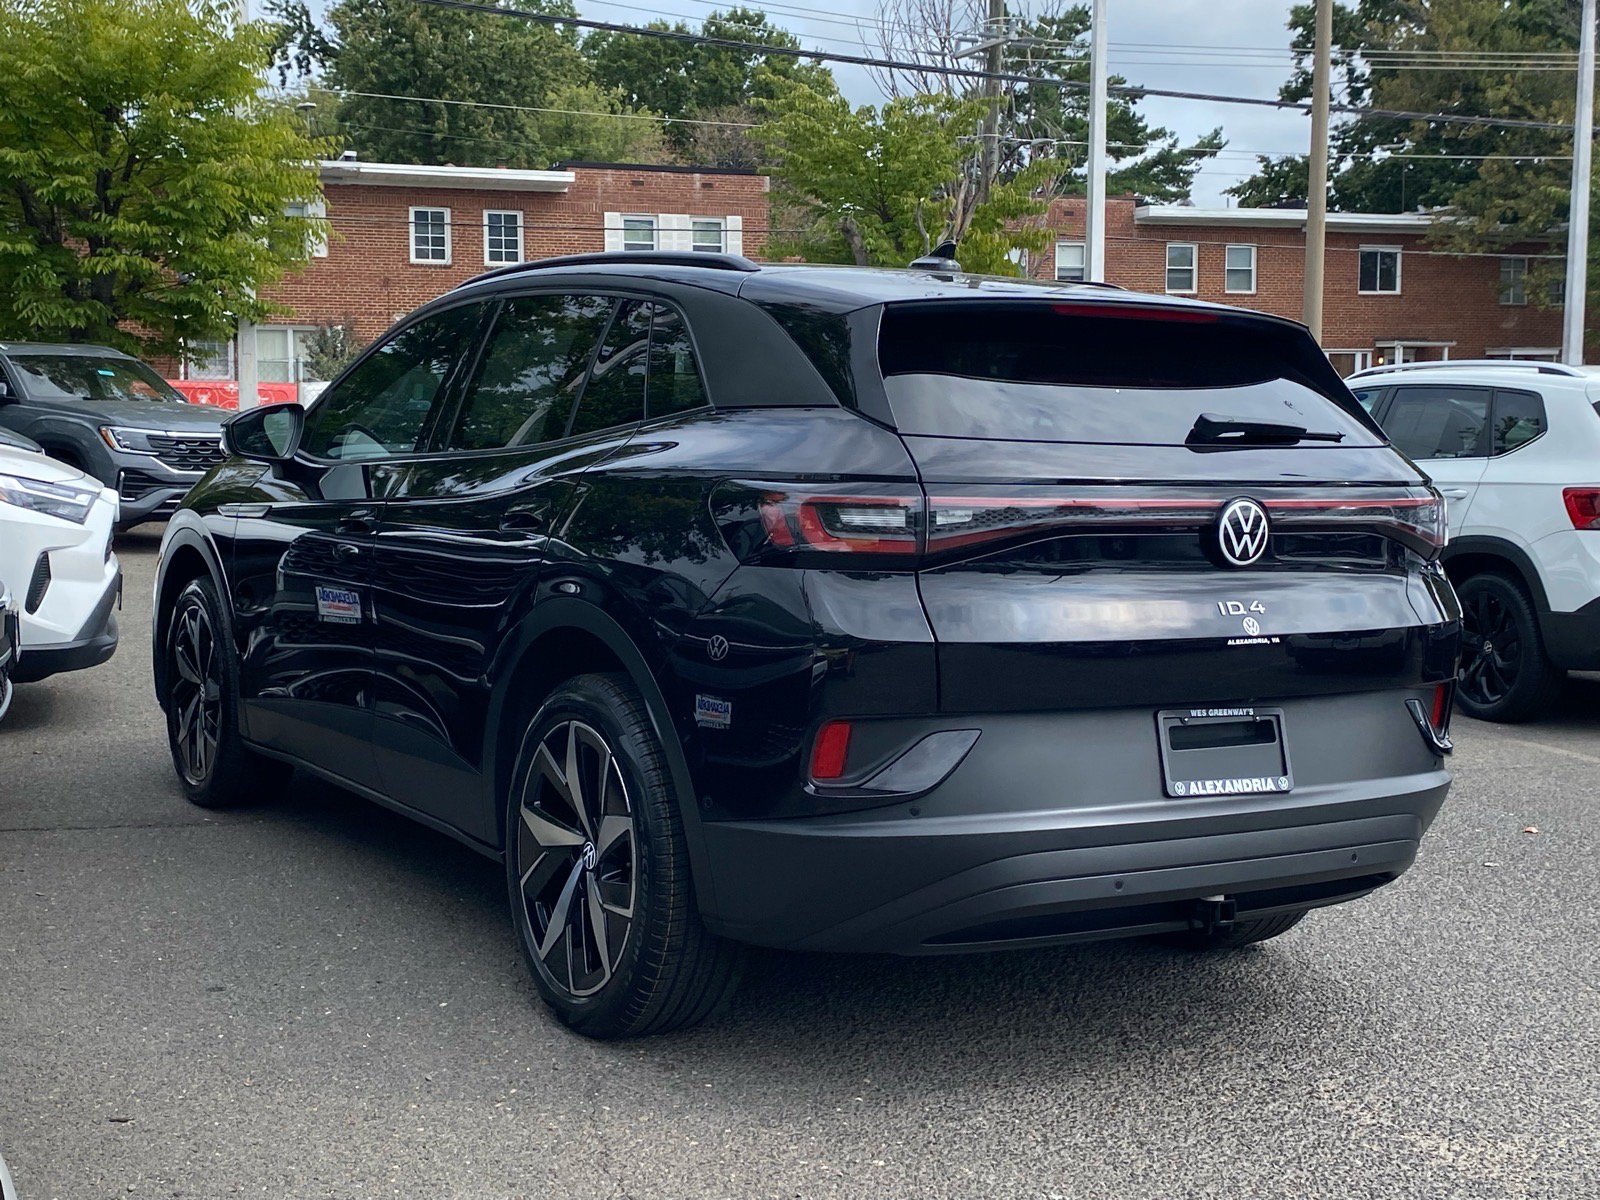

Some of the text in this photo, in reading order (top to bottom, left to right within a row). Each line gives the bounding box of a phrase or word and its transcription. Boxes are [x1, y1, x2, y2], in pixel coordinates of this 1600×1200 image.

[1190, 708, 1253, 717] WES GREENWAY'S
[1189, 777, 1277, 795] ALEXANDRIA
